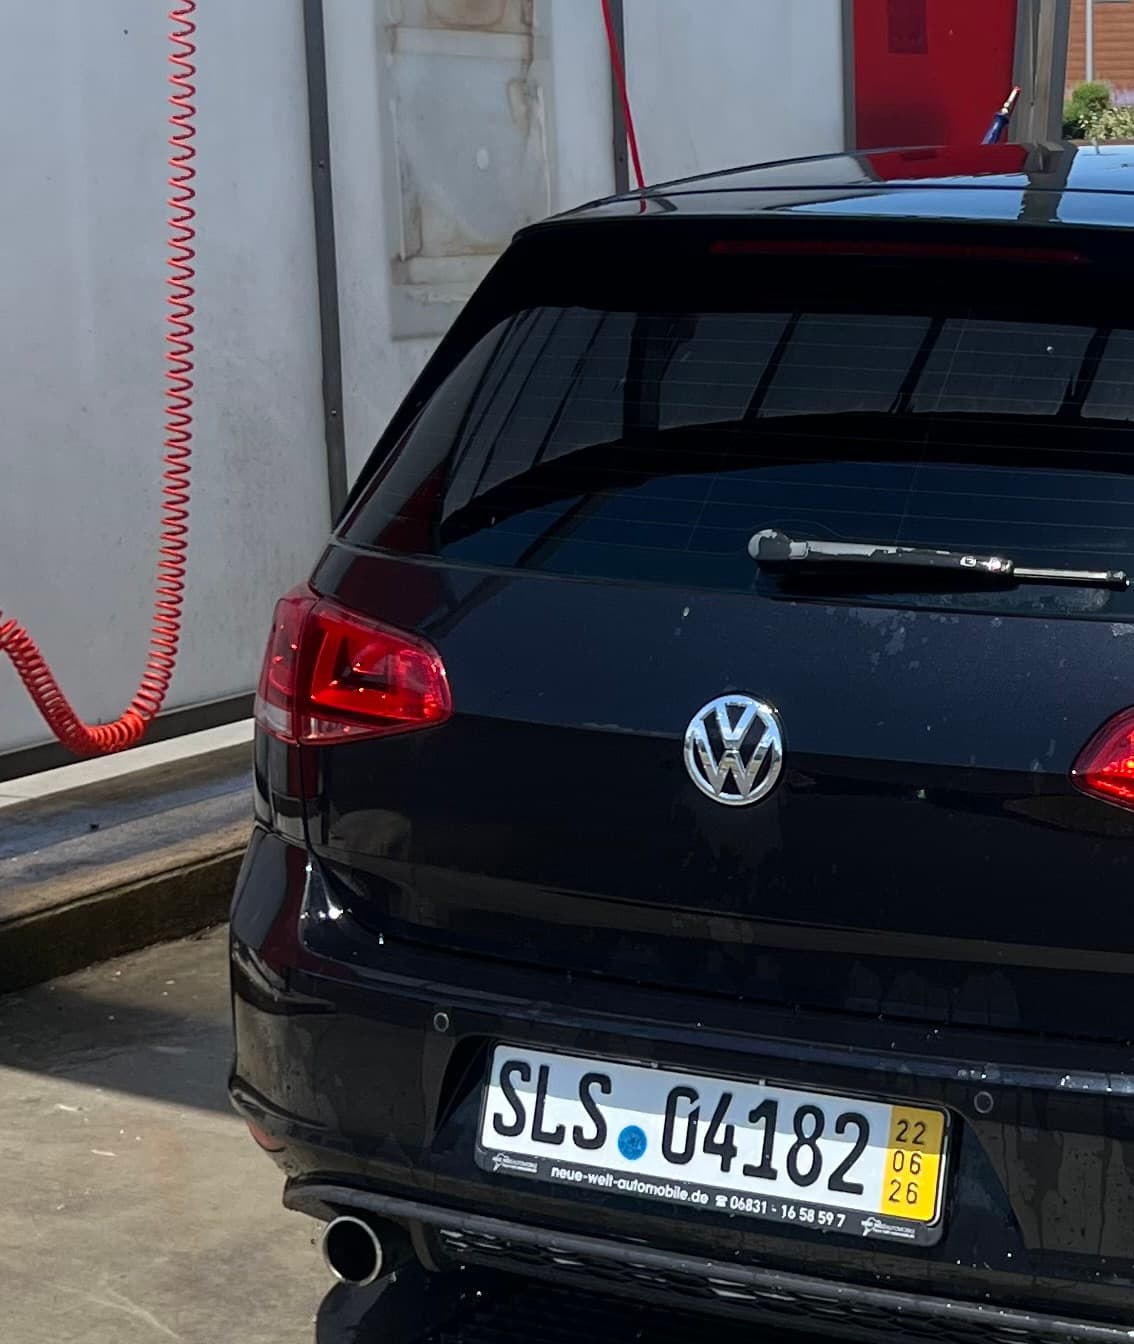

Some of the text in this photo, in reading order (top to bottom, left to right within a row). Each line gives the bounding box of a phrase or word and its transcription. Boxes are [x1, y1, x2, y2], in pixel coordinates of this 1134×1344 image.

[492, 1059, 870, 1196] SLS 04182
[895, 1119, 926, 1145] 22
[892, 1150, 922, 1175] 06
[551, 1166, 709, 1205] neue-welt-automobile.de
[730, 1195, 767, 1214] 06831
[781, 1204, 796, 1220] 16
[799, 1207, 815, 1223] 58
[817, 1210, 834, 1226] 59
[836, 1213, 847, 1228] 7
[888, 1179, 919, 1204] 26
